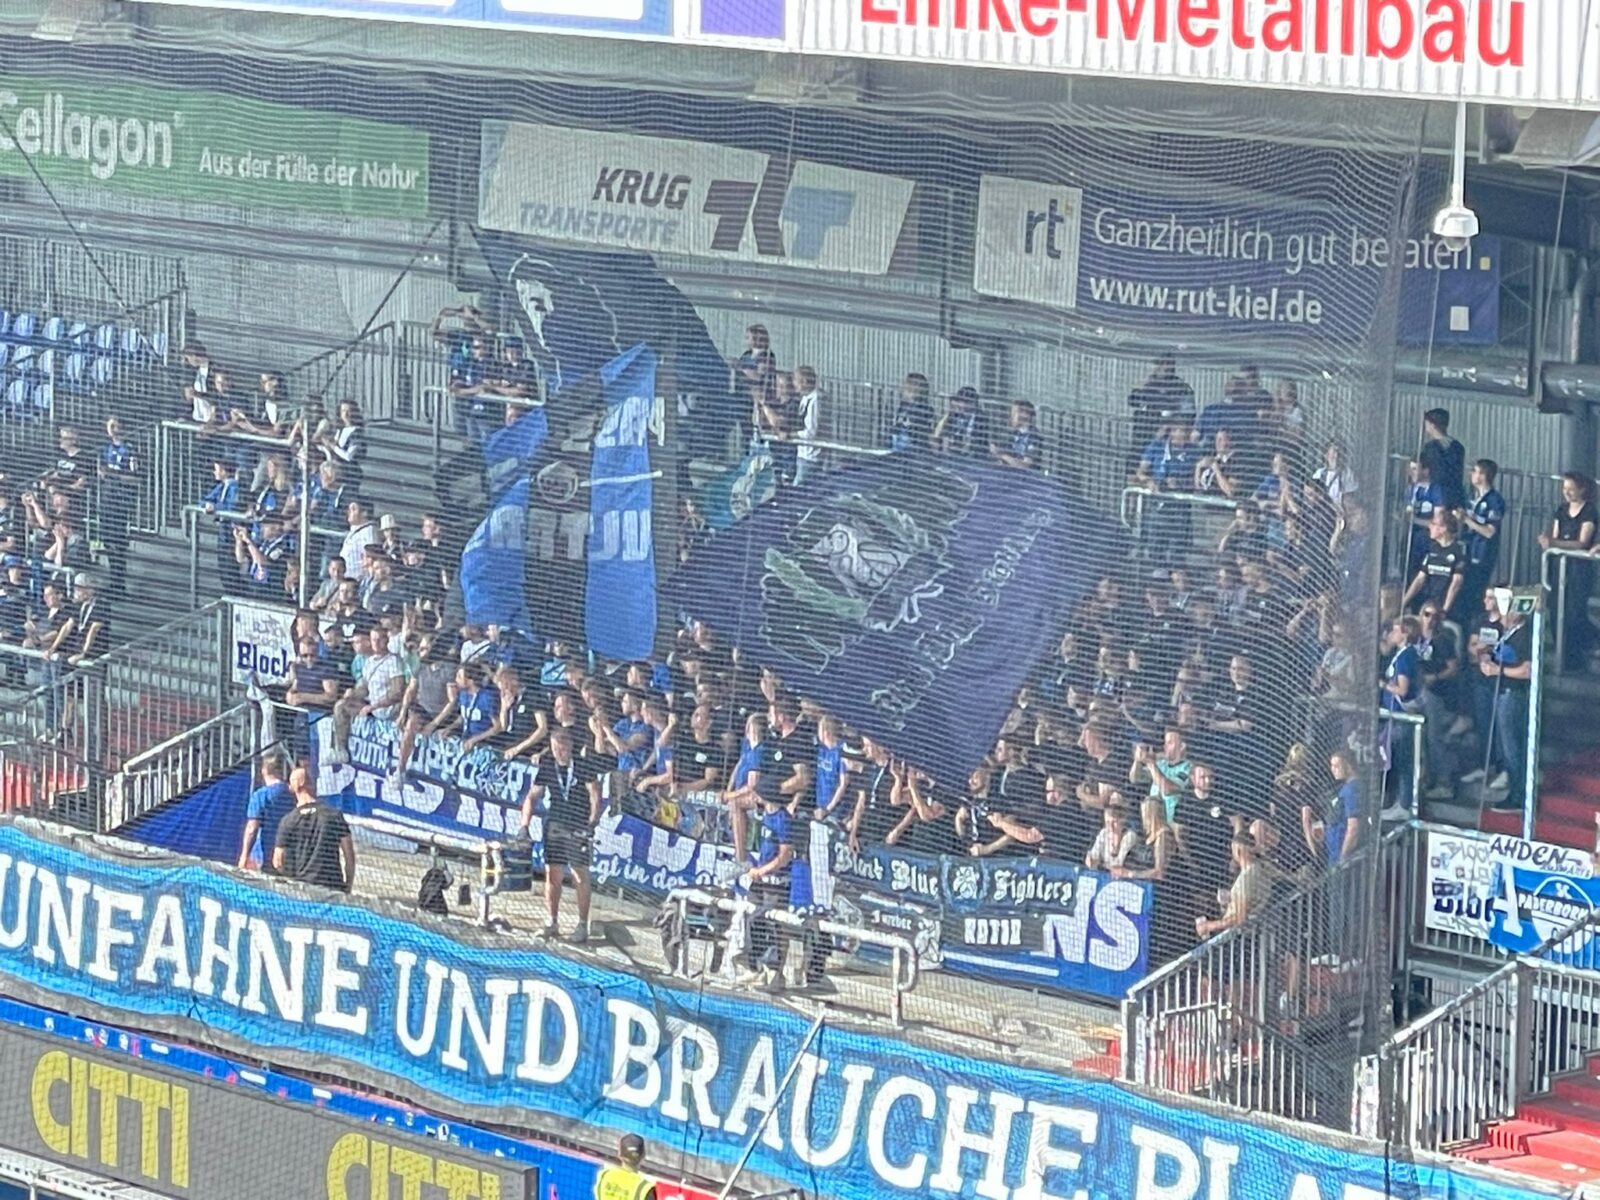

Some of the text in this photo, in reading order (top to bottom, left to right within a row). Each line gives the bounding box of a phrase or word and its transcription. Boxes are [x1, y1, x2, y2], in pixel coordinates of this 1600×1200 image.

[200, 147, 420, 190] Aus der Fülle der Natur
[592, 166, 692, 210] KRUG
[519, 201, 681, 244] TRANSPORTE
[1024, 198, 1064, 260] rt
[1094, 206, 1491, 275] Ganzheitlich gut beaten.
[1089, 275, 1323, 325] www.rut-kiel.de
[890, 859, 939, 896] Blue
[1518, 892, 1589, 921] PADERBORN
[394, 950, 578, 1083] UND
[602, 998, 1098, 1200] BRAUCHE
[30, 1049, 190, 1188] CITTI
[326, 1132, 500, 1200] CITT
